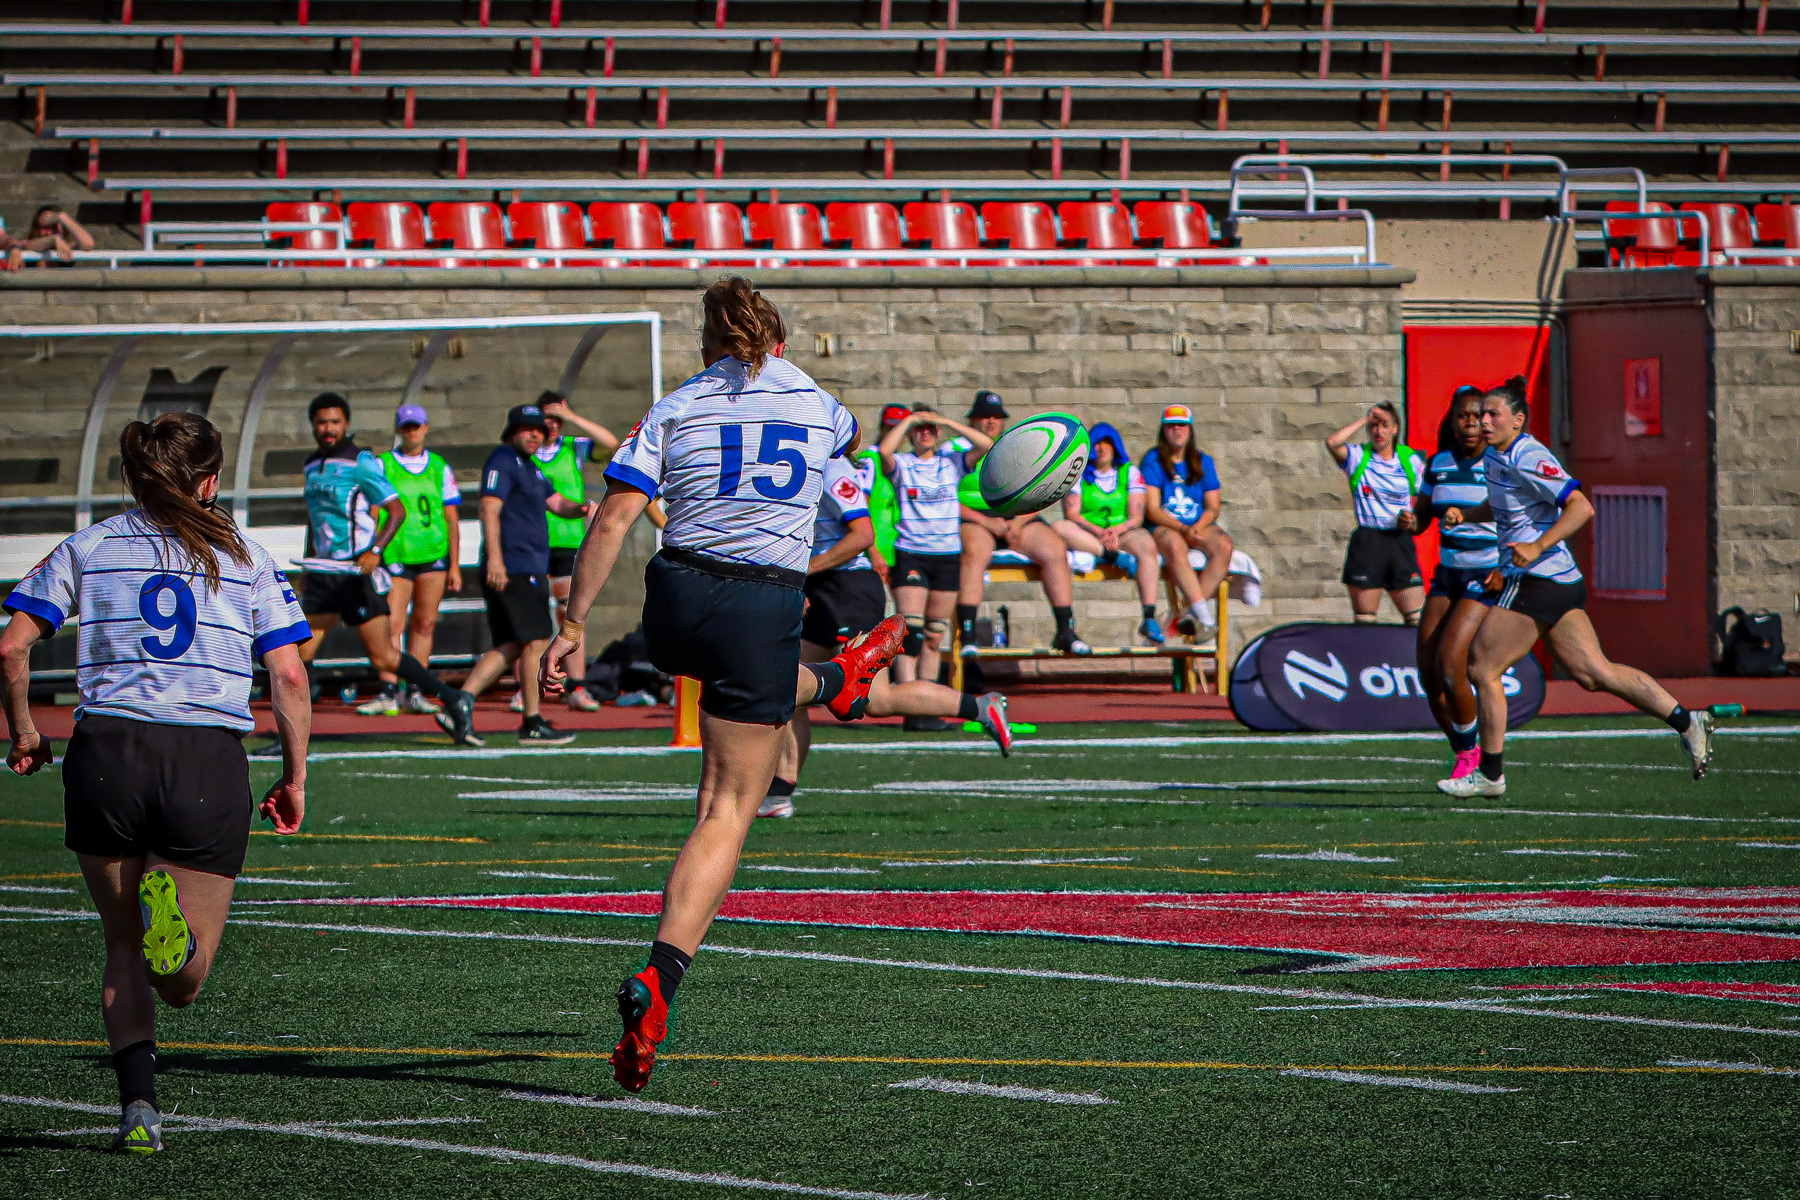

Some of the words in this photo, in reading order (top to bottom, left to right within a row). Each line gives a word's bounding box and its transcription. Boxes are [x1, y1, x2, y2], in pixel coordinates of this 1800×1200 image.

[715, 423, 808, 501] 15
[1037, 456, 1084, 507] GILB
[418, 494, 430, 528] 9
[138, 573, 198, 660] 9
[1359, 662, 1522, 698] o'ns
